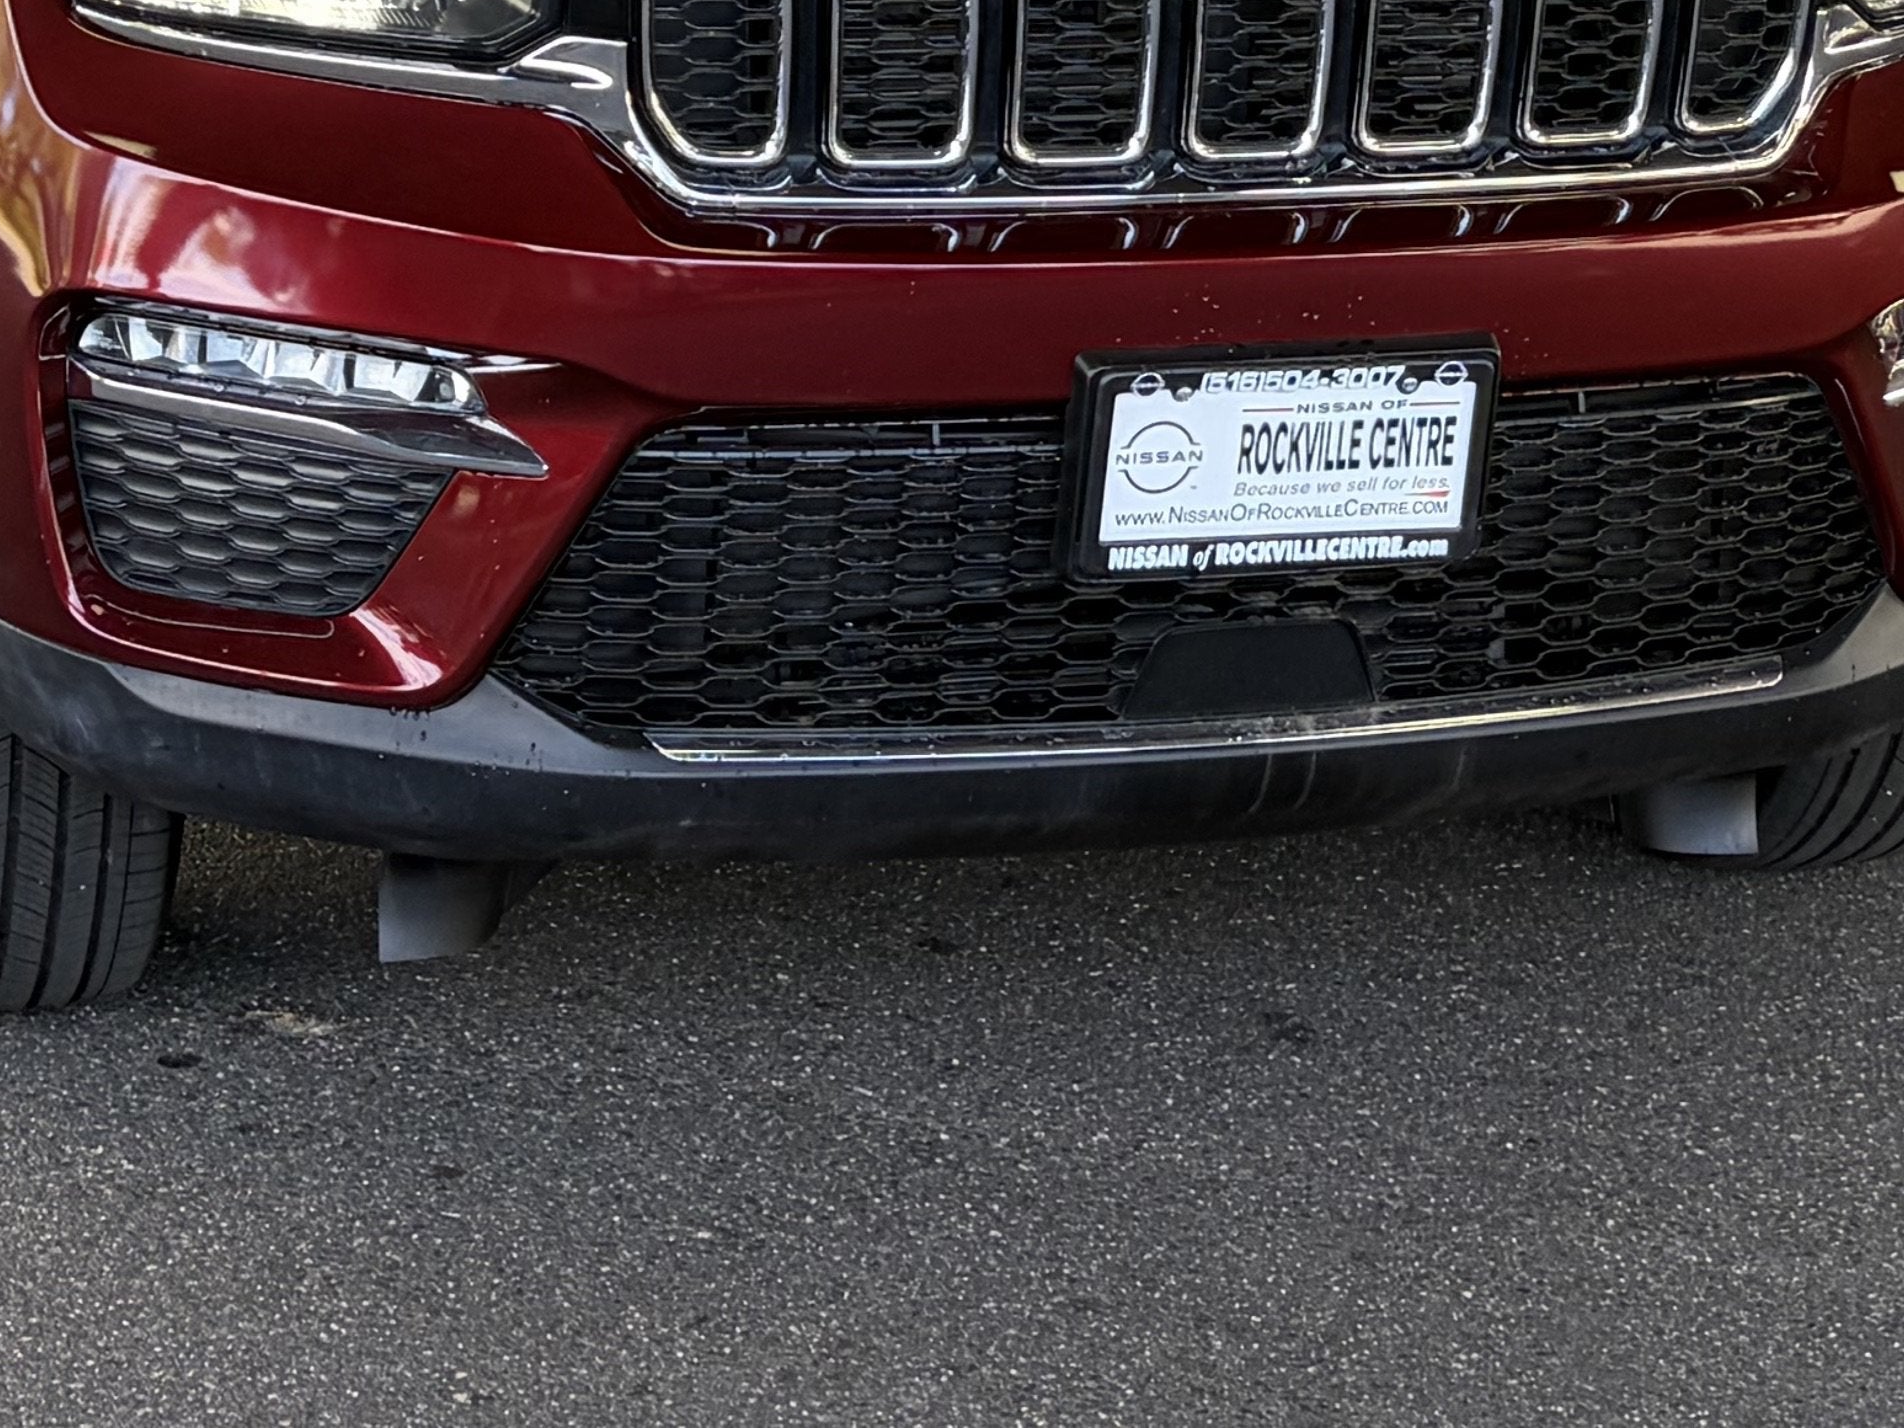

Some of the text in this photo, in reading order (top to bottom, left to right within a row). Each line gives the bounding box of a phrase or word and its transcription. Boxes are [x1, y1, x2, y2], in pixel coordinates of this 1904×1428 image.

[1297, 399, 1408, 414] NISSAN OF
[1237, 415, 1458, 475] ROCKVILLE CENTRE
[1115, 449, 1204, 466] NISSAN
[1234, 481, 1310, 496] Because
[1316, 482, 1342, 493] we
[1346, 477, 1379, 492] sell
[1381, 476, 1408, 490] for
[1107, 543, 1190, 571] NISSAN
[1192, 544, 1215, 572] of
